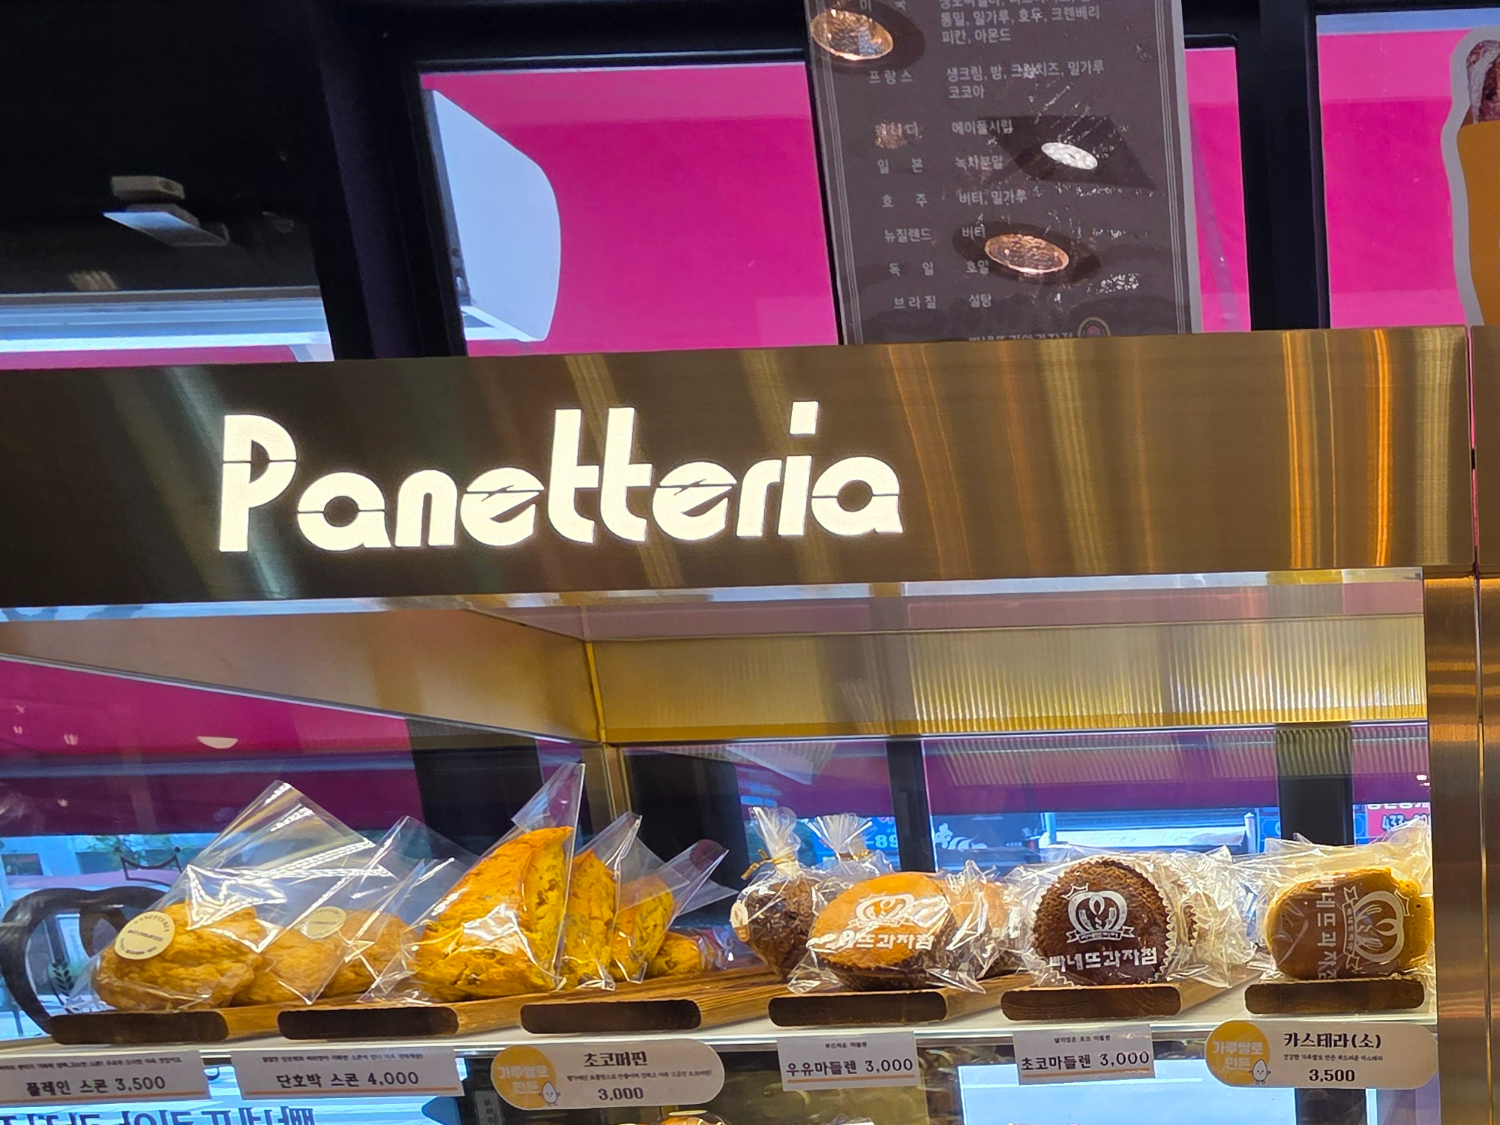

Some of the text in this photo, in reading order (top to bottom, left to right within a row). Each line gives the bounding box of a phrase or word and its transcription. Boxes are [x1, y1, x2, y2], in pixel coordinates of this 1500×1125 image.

[973, 10, 1015, 25] 밀가루,
[942, 28, 1012, 44] 피칸, 아몬드
[868, 71, 913, 86] 프랑스
[946, 66, 988, 82] 생크림,
[1068, 59, 1105, 75] 밀가루
[948, 85, 985, 99] 코코아
[952, 119, 1014, 136] 메이플시럽
[991, 188, 1027, 205] 밀가루
[962, 225, 986, 239] 버터
[966, 260, 989, 274] 호밀
[893, 296, 937, 310] 브라질
[969, 293, 992, 308] 설탕
[219, 401, 903, 552] Panetteria
[1213, 1040, 1263, 1056] 가루쌀로
[1284, 1033, 1382, 1049] 카스테라(소)
[583, 1051, 648, 1068] 초코머핀
[786, 1058, 913, 1077] 우유마들렌 3,000
[1021, 1051, 1149, 1071] 초코마들렌 3,000
[276, 1071, 419, 1088] 단호박 스콘 4,000
[1309, 1069, 1356, 1082] 3,500
[26, 1076, 166, 1097] 플레인 스콘 3,500
[598, 1087, 644, 1101] 3,000
